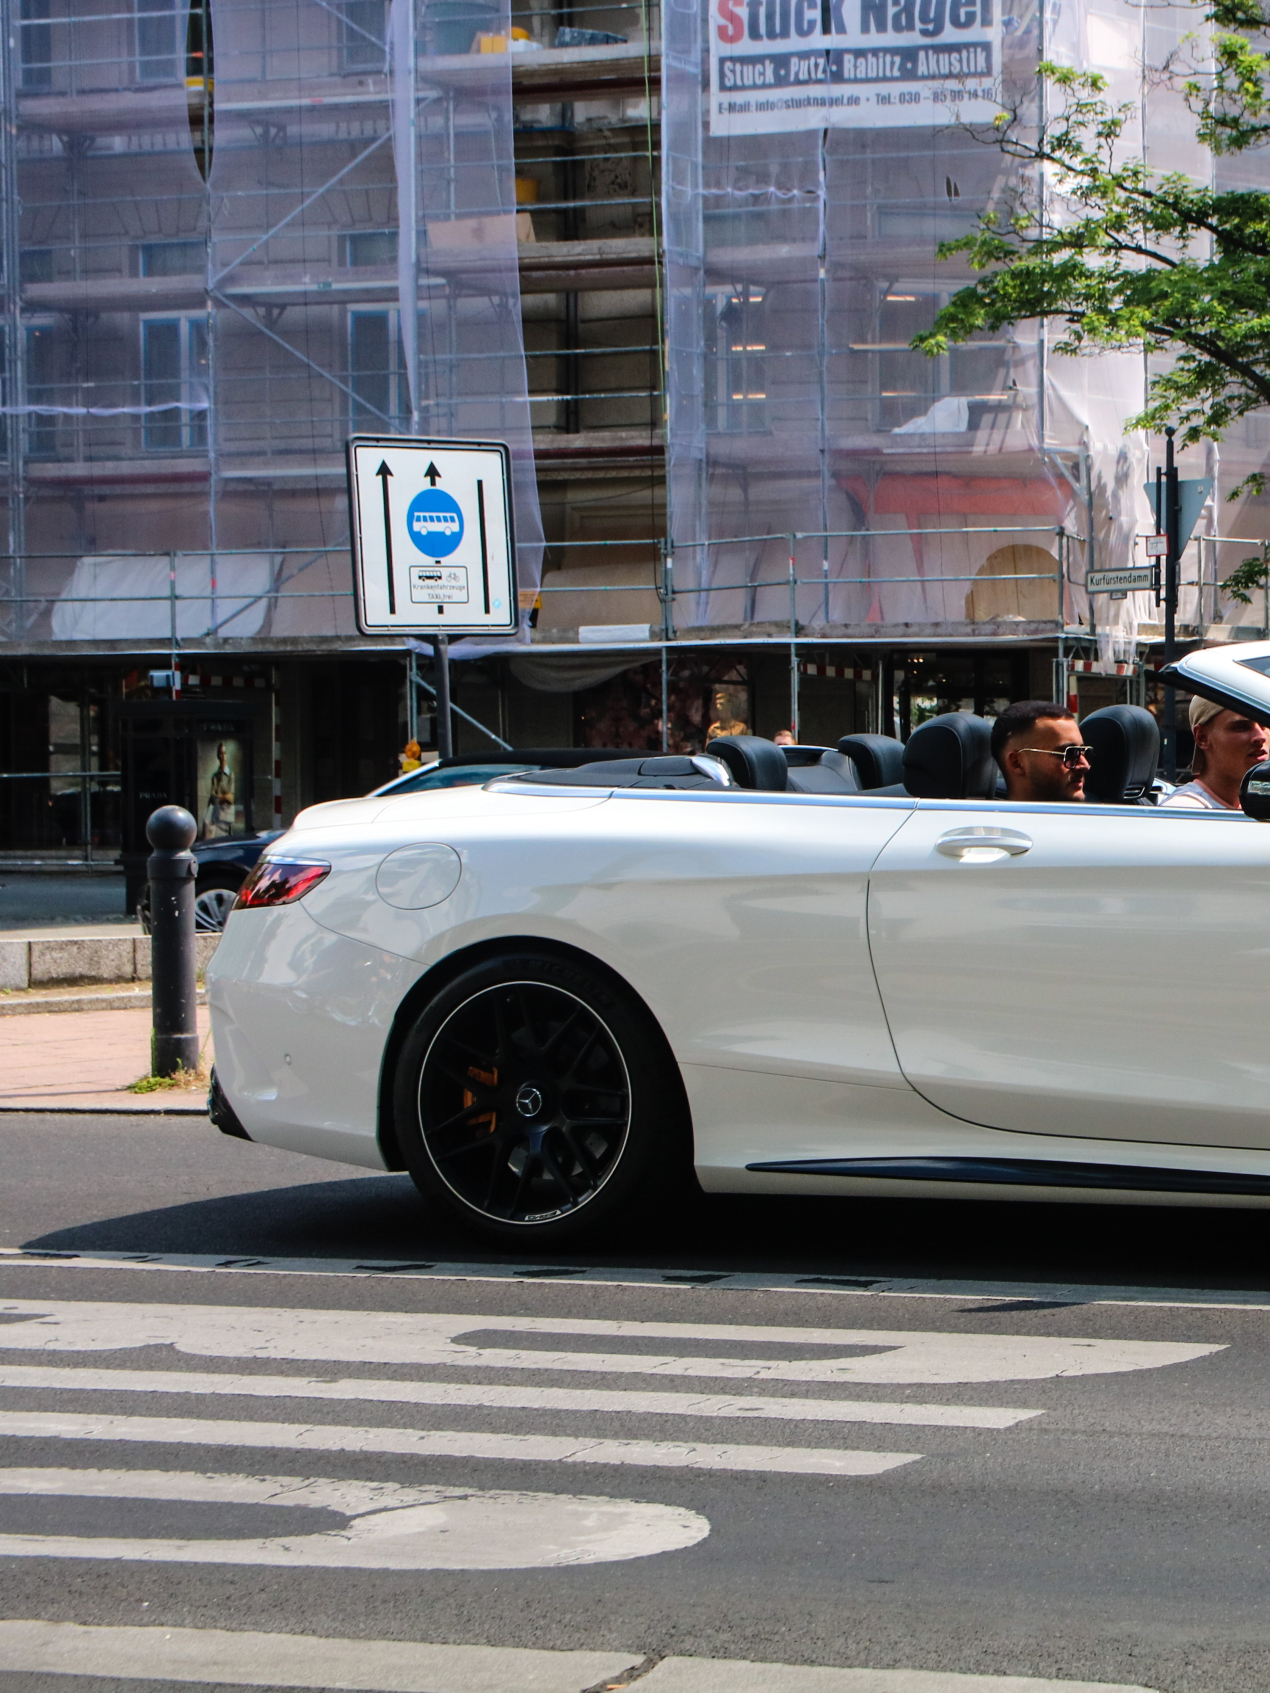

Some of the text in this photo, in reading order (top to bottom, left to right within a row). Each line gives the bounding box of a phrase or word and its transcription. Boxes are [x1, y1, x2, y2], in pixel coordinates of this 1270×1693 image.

[717, 0, 993, 45] Stuck Nagel
[724, 47, 986, 87] Stuck Putz Rabitz Akustik
[899, 92, 920, 104] 030
[1090, 573, 1149, 587] Kurfürstendamm
[413, 584, 466, 592] Krankenfahrzeuge
